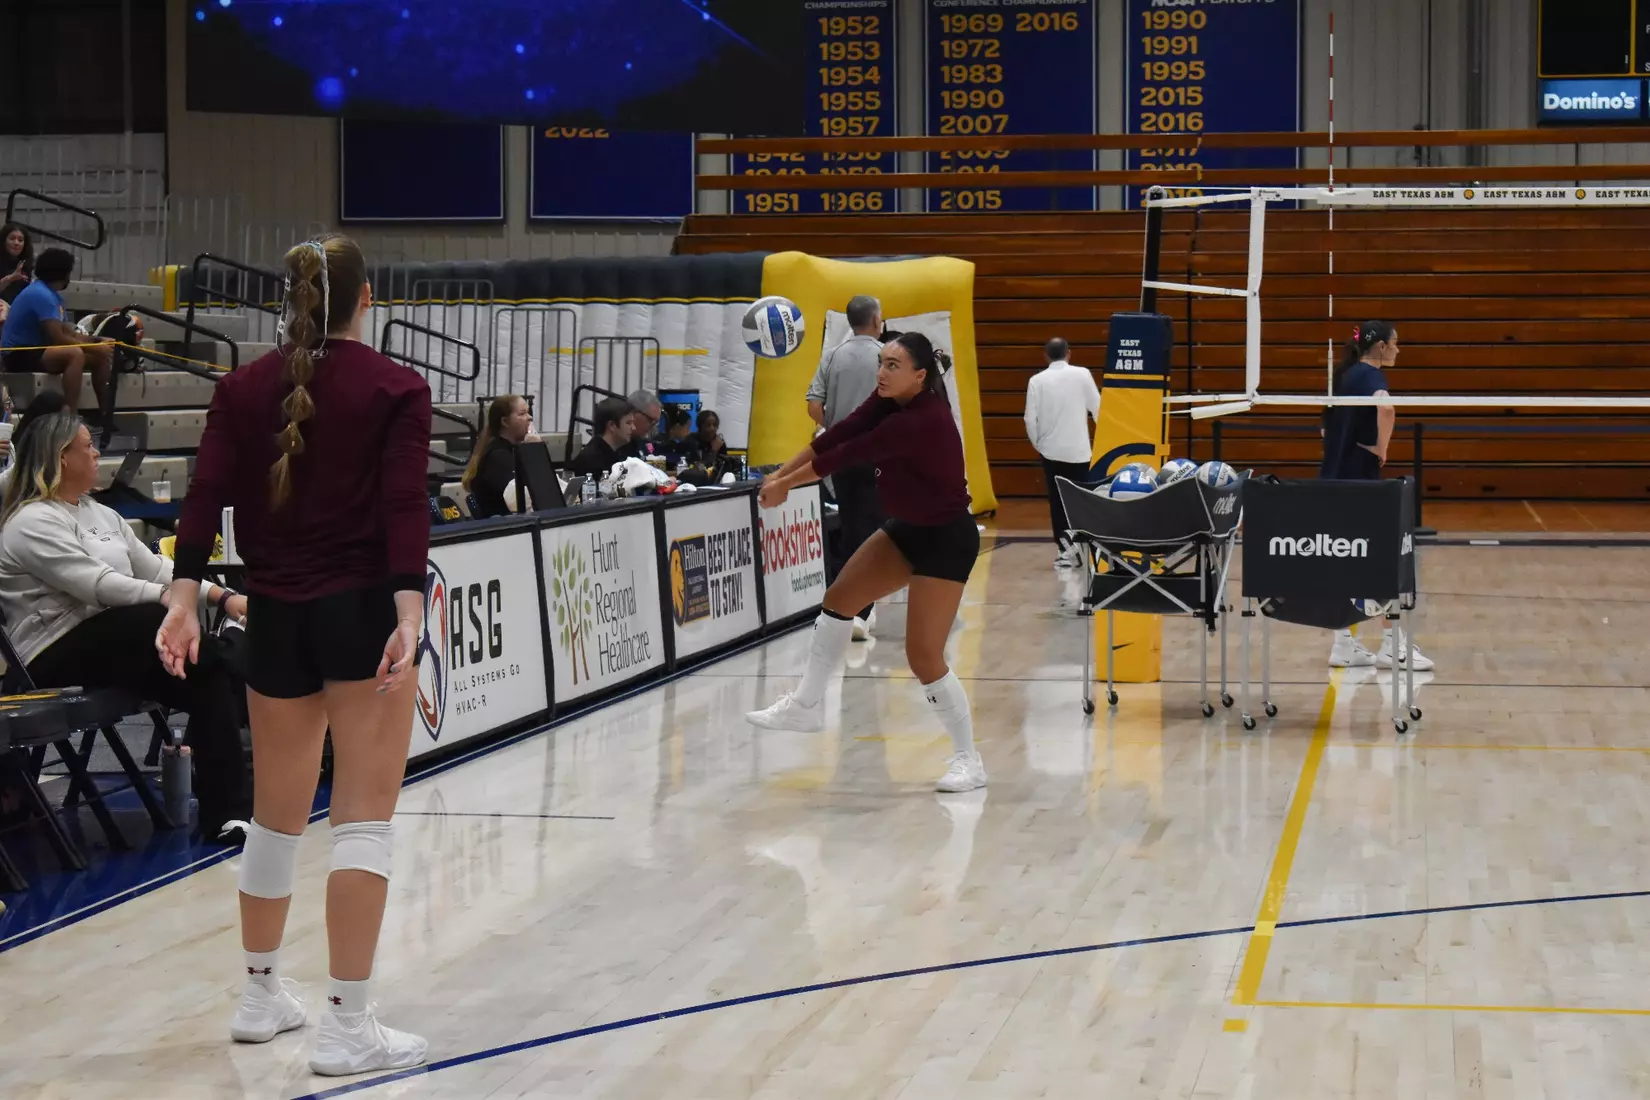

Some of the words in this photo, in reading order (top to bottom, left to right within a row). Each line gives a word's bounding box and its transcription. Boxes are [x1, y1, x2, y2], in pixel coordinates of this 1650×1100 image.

[804, 1, 887, 9] CHAMPIONSHIPS
[819, 16, 880, 36] 1952
[940, 14, 1003, 33] 1969
[1015, 12, 1078, 32] 2016
[1142, 10, 1207, 30] 1990
[819, 42, 881, 61] 1953
[940, 39, 1000, 58] 1972
[1142, 36, 1198, 55] 1991
[819, 66, 881, 86] 1954
[940, 64, 1003, 84] 1983
[1142, 61, 1206, 81] 1995
[819, 91, 881, 111] 1955
[940, 89, 1005, 109] 1990
[1141, 87, 1203, 106] 2015
[1543, 91, 1636, 110] Domino's
[820, 117, 880, 136] 1957
[940, 115, 1009, 134] 2007
[1141, 112, 1204, 132] 2016
[745, 193, 800, 212] 1951
[820, 192, 883, 212] 1966
[940, 190, 1003, 210] 2015
[1623, 190, 1650, 198] TEXA
[782, 311, 795, 345] molten
[1117, 349, 1142, 357] TEXAS
[1120, 339, 1140, 347] EAST
[1115, 359, 1144, 371] A&M
[591, 531, 620, 575] Hunt
[707, 532, 726, 575] BEST
[728, 526, 751, 570] PLACE
[1269, 533, 1368, 557] molten
[683, 543, 706, 571] Hilton
[594, 569, 637, 637] Regional
[709, 578, 721, 619] TO
[722, 571, 743, 616] STAY!
[450, 578, 503, 671] ASG
[597, 622, 652, 676] Healthcare
[453, 680, 468, 694] ALL
[471, 668, 506, 688] SYSTEMS
[509, 663, 520, 676] GO
[455, 694, 487, 716] HVAC-R
